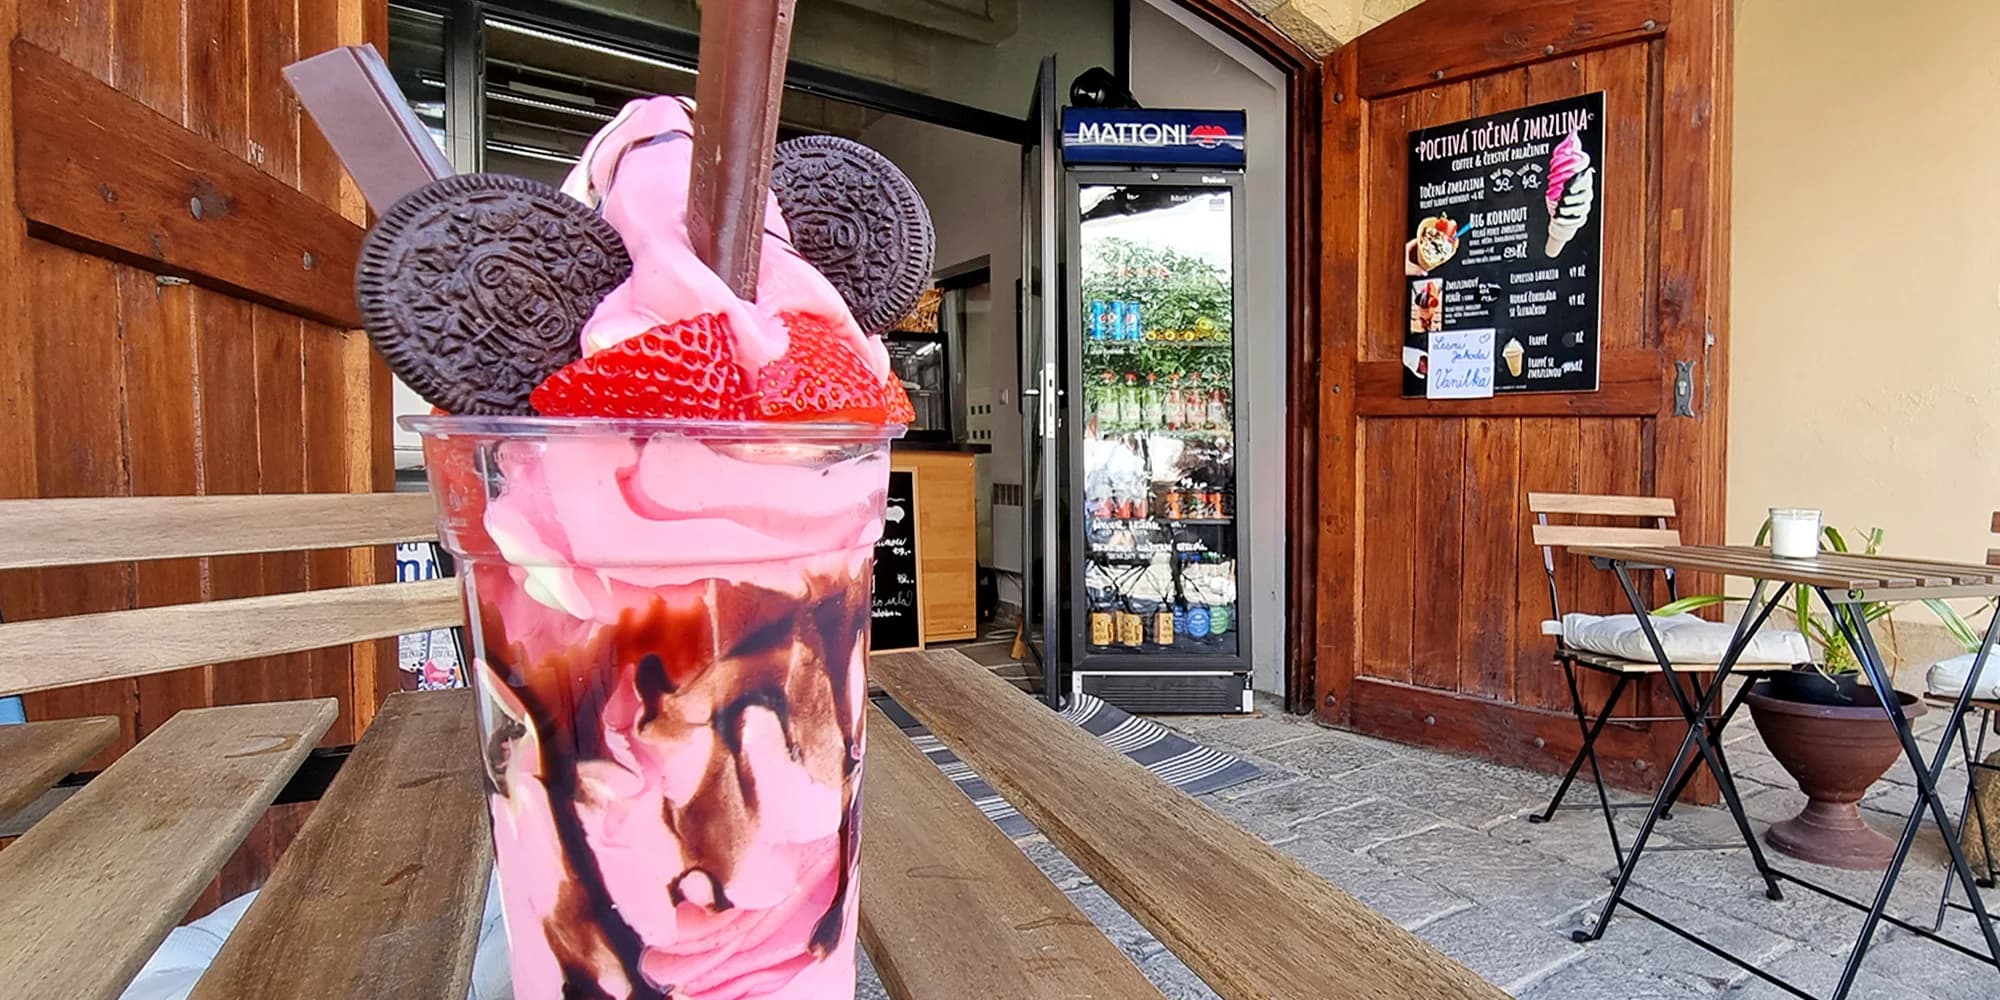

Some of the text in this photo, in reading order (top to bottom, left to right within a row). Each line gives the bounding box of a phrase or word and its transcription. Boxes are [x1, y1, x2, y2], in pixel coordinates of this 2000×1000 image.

[1078, 122, 1187, 145] MATTONI
[1420, 108, 1588, 161] POCTIVÁ TOČENÁ ZMRZLINA
[1452, 157, 1474, 171] COFFEE
[1475, 155, 1482, 167] &
[1511, 143, 1550, 161] PALAČINKY
[1470, 206, 1528, 228] BIG KORNOUT
